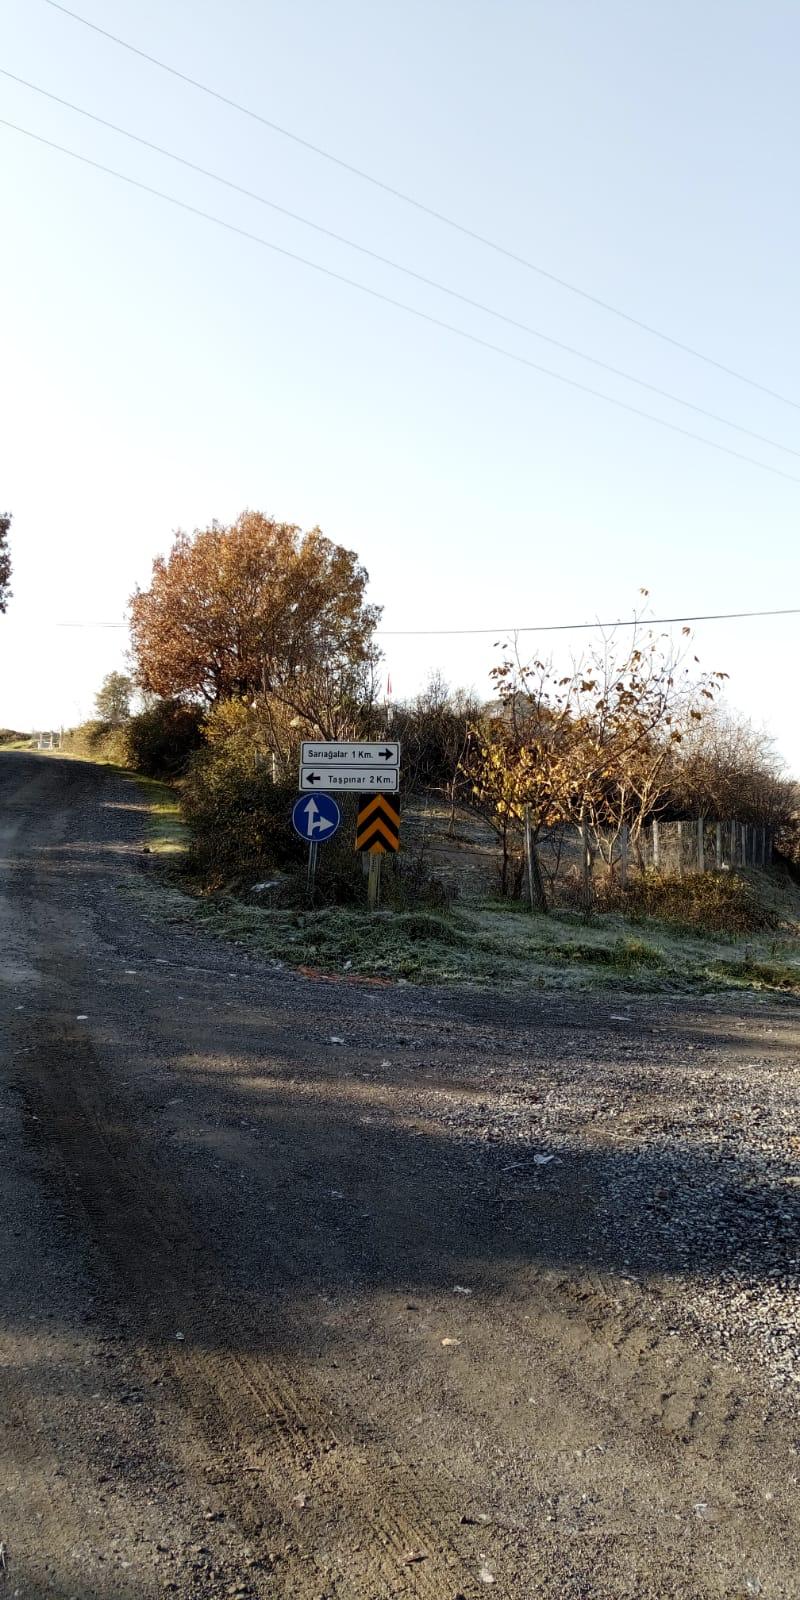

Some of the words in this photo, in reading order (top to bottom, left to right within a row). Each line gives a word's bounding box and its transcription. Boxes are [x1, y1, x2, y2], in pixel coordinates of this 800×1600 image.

[308, 750, 348, 759] Sarıağalar
[352, 751, 356, 759] 1
[358, 751, 374, 759] Km.
[328, 775, 366, 785] Taşpınar
[369, 775, 375, 783] 2
